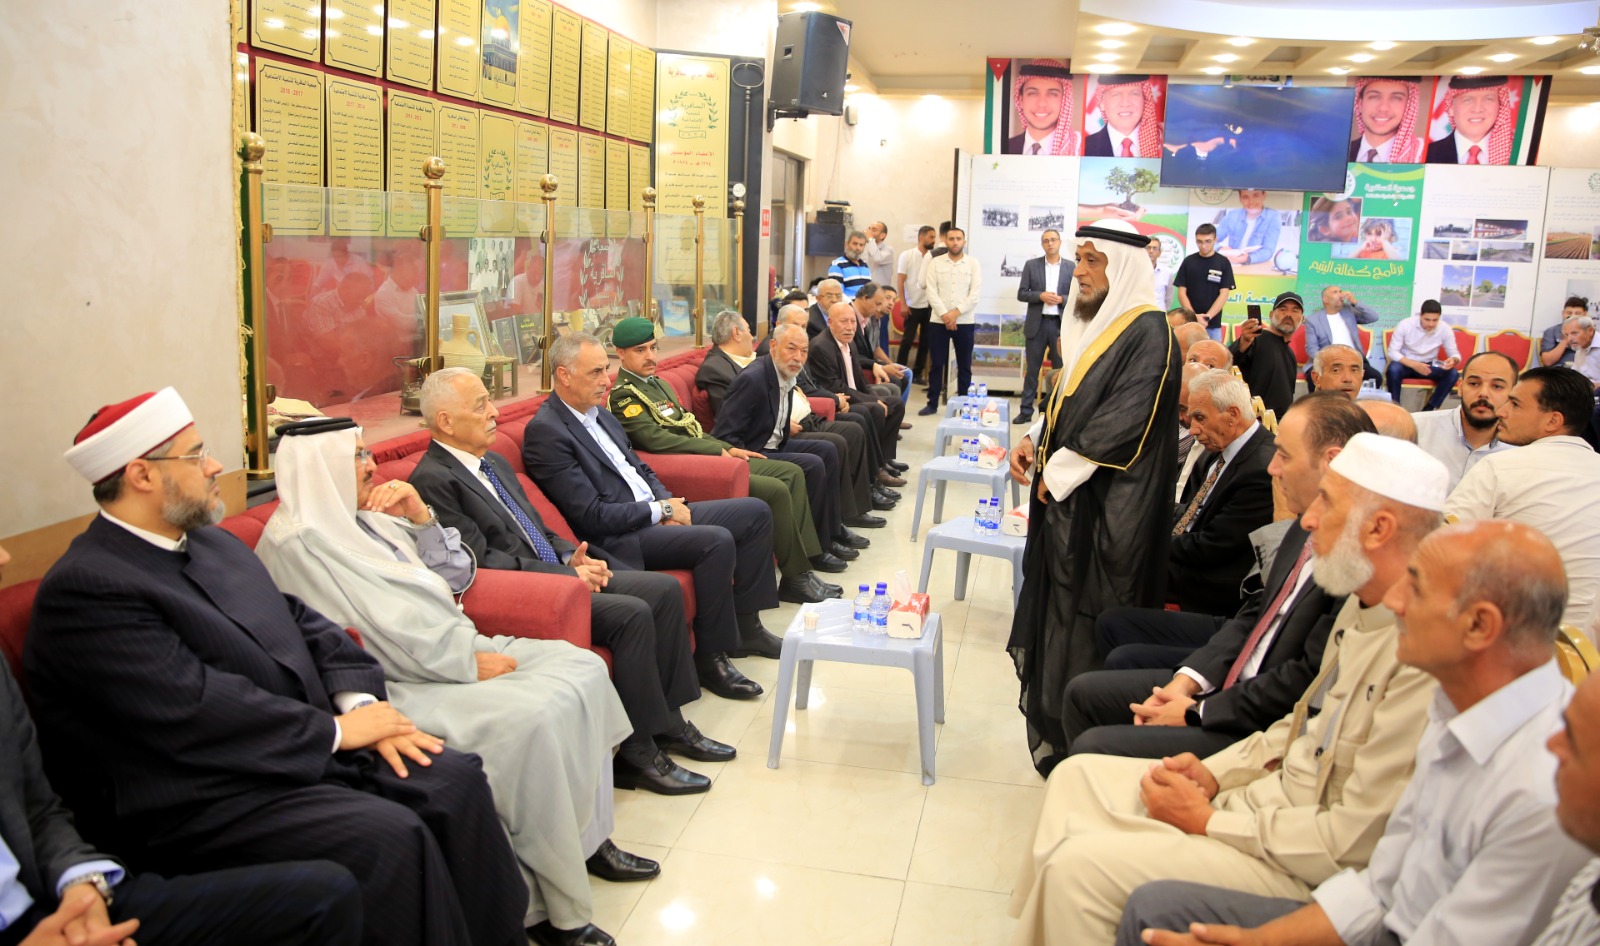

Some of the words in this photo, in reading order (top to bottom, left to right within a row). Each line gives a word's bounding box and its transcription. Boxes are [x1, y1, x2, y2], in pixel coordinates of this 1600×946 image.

[1308, 260, 1334, 275] اليتيم
[1333, 262, 1371, 278] كفالة
[1373, 261, 1405, 280] برنامج
[1246, 291, 1277, 304] معية
